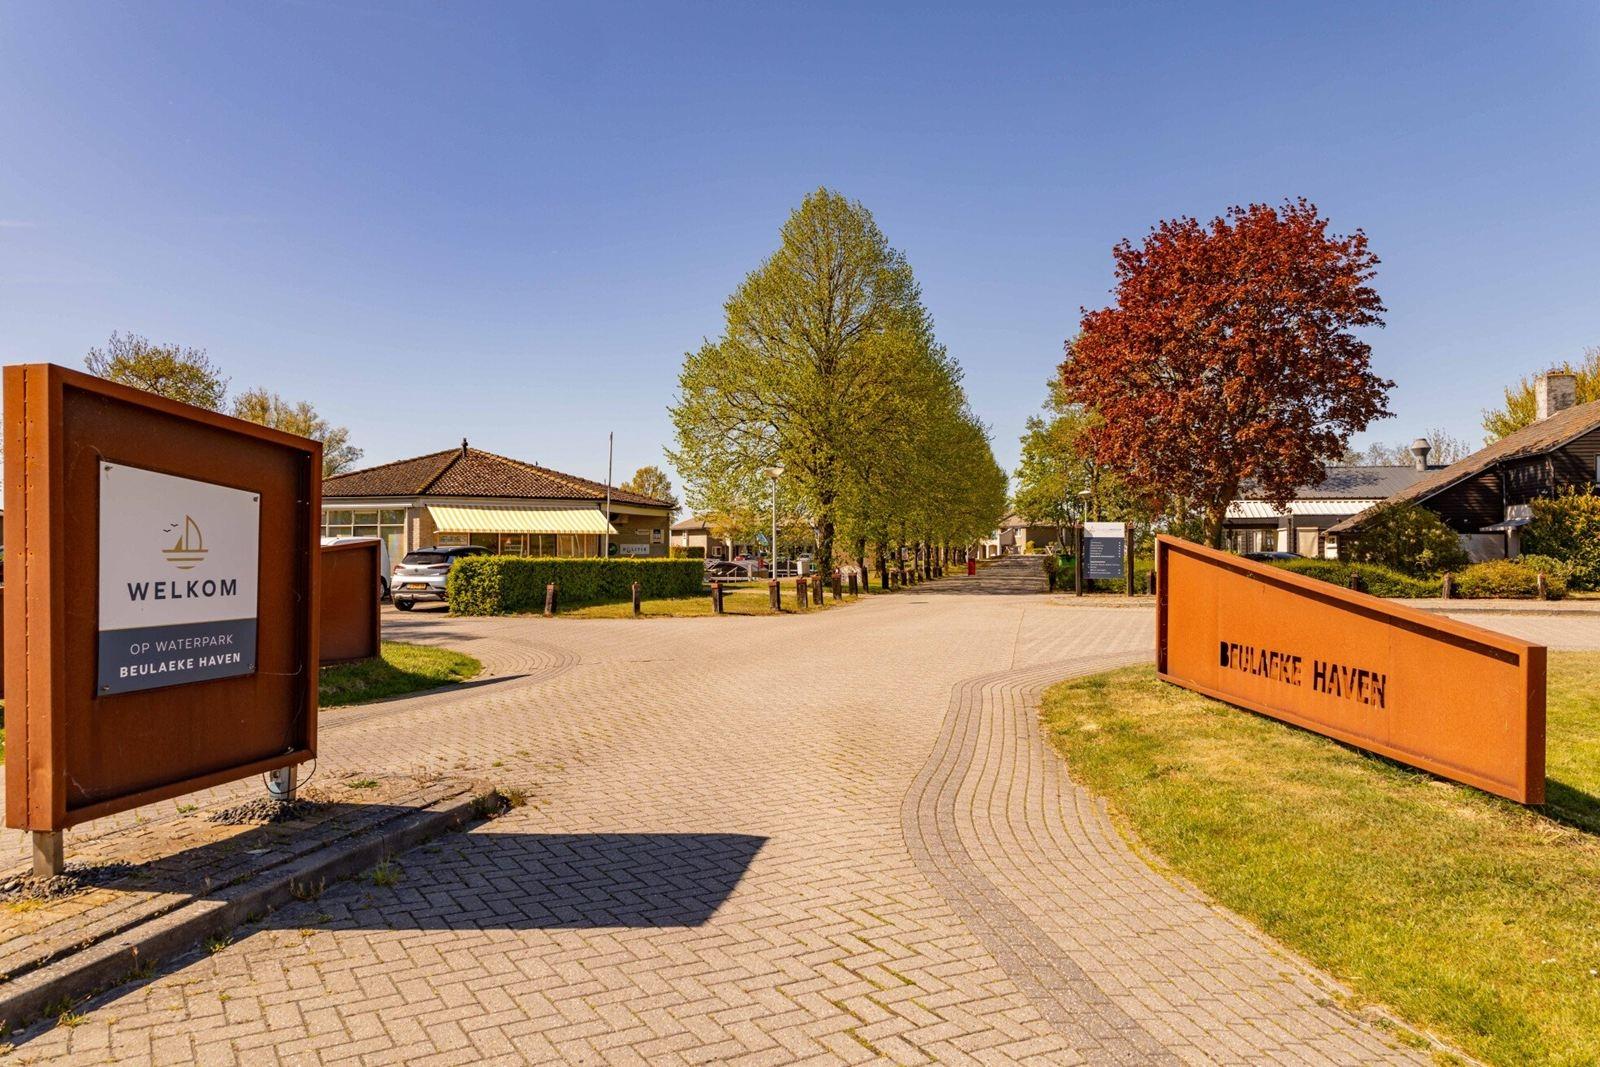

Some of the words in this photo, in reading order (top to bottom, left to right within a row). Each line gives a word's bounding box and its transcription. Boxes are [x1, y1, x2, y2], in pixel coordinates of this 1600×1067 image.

[127, 578, 237, 601] WELKOM
[130, 643, 150, 655] OP
[156, 634, 233, 652] WATERPARK
[119, 658, 194, 678] BEULAEKE
[199, 652, 241, 667] HAVEN
[1313, 660, 1387, 709] HAVEN
